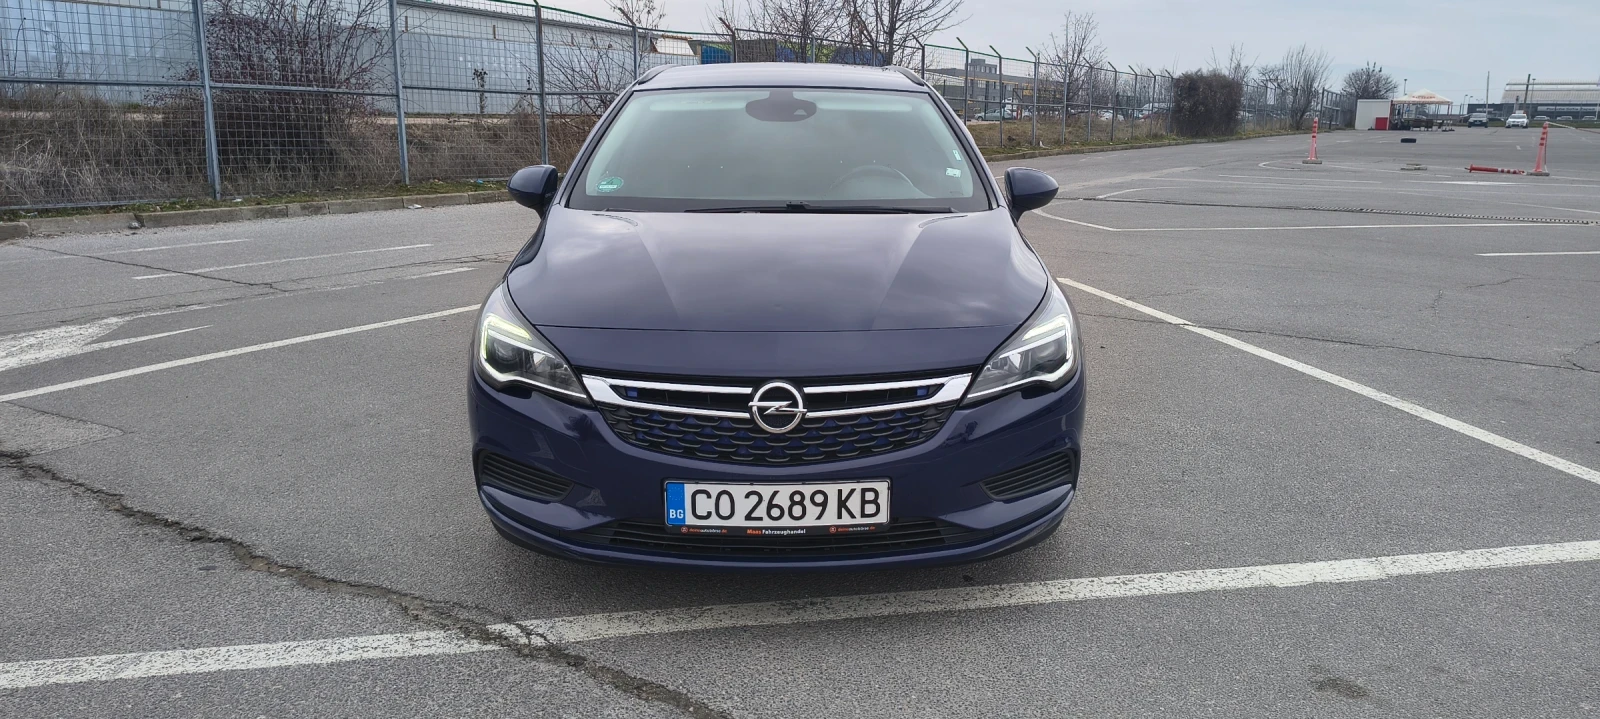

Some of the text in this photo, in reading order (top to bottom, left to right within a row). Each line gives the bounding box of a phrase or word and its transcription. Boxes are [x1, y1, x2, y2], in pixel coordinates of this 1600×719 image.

[690, 487, 881, 522] CO 2689 KB
[669, 509, 684, 519] BG
[762, 528, 806, 536] Fahrzeughandel
